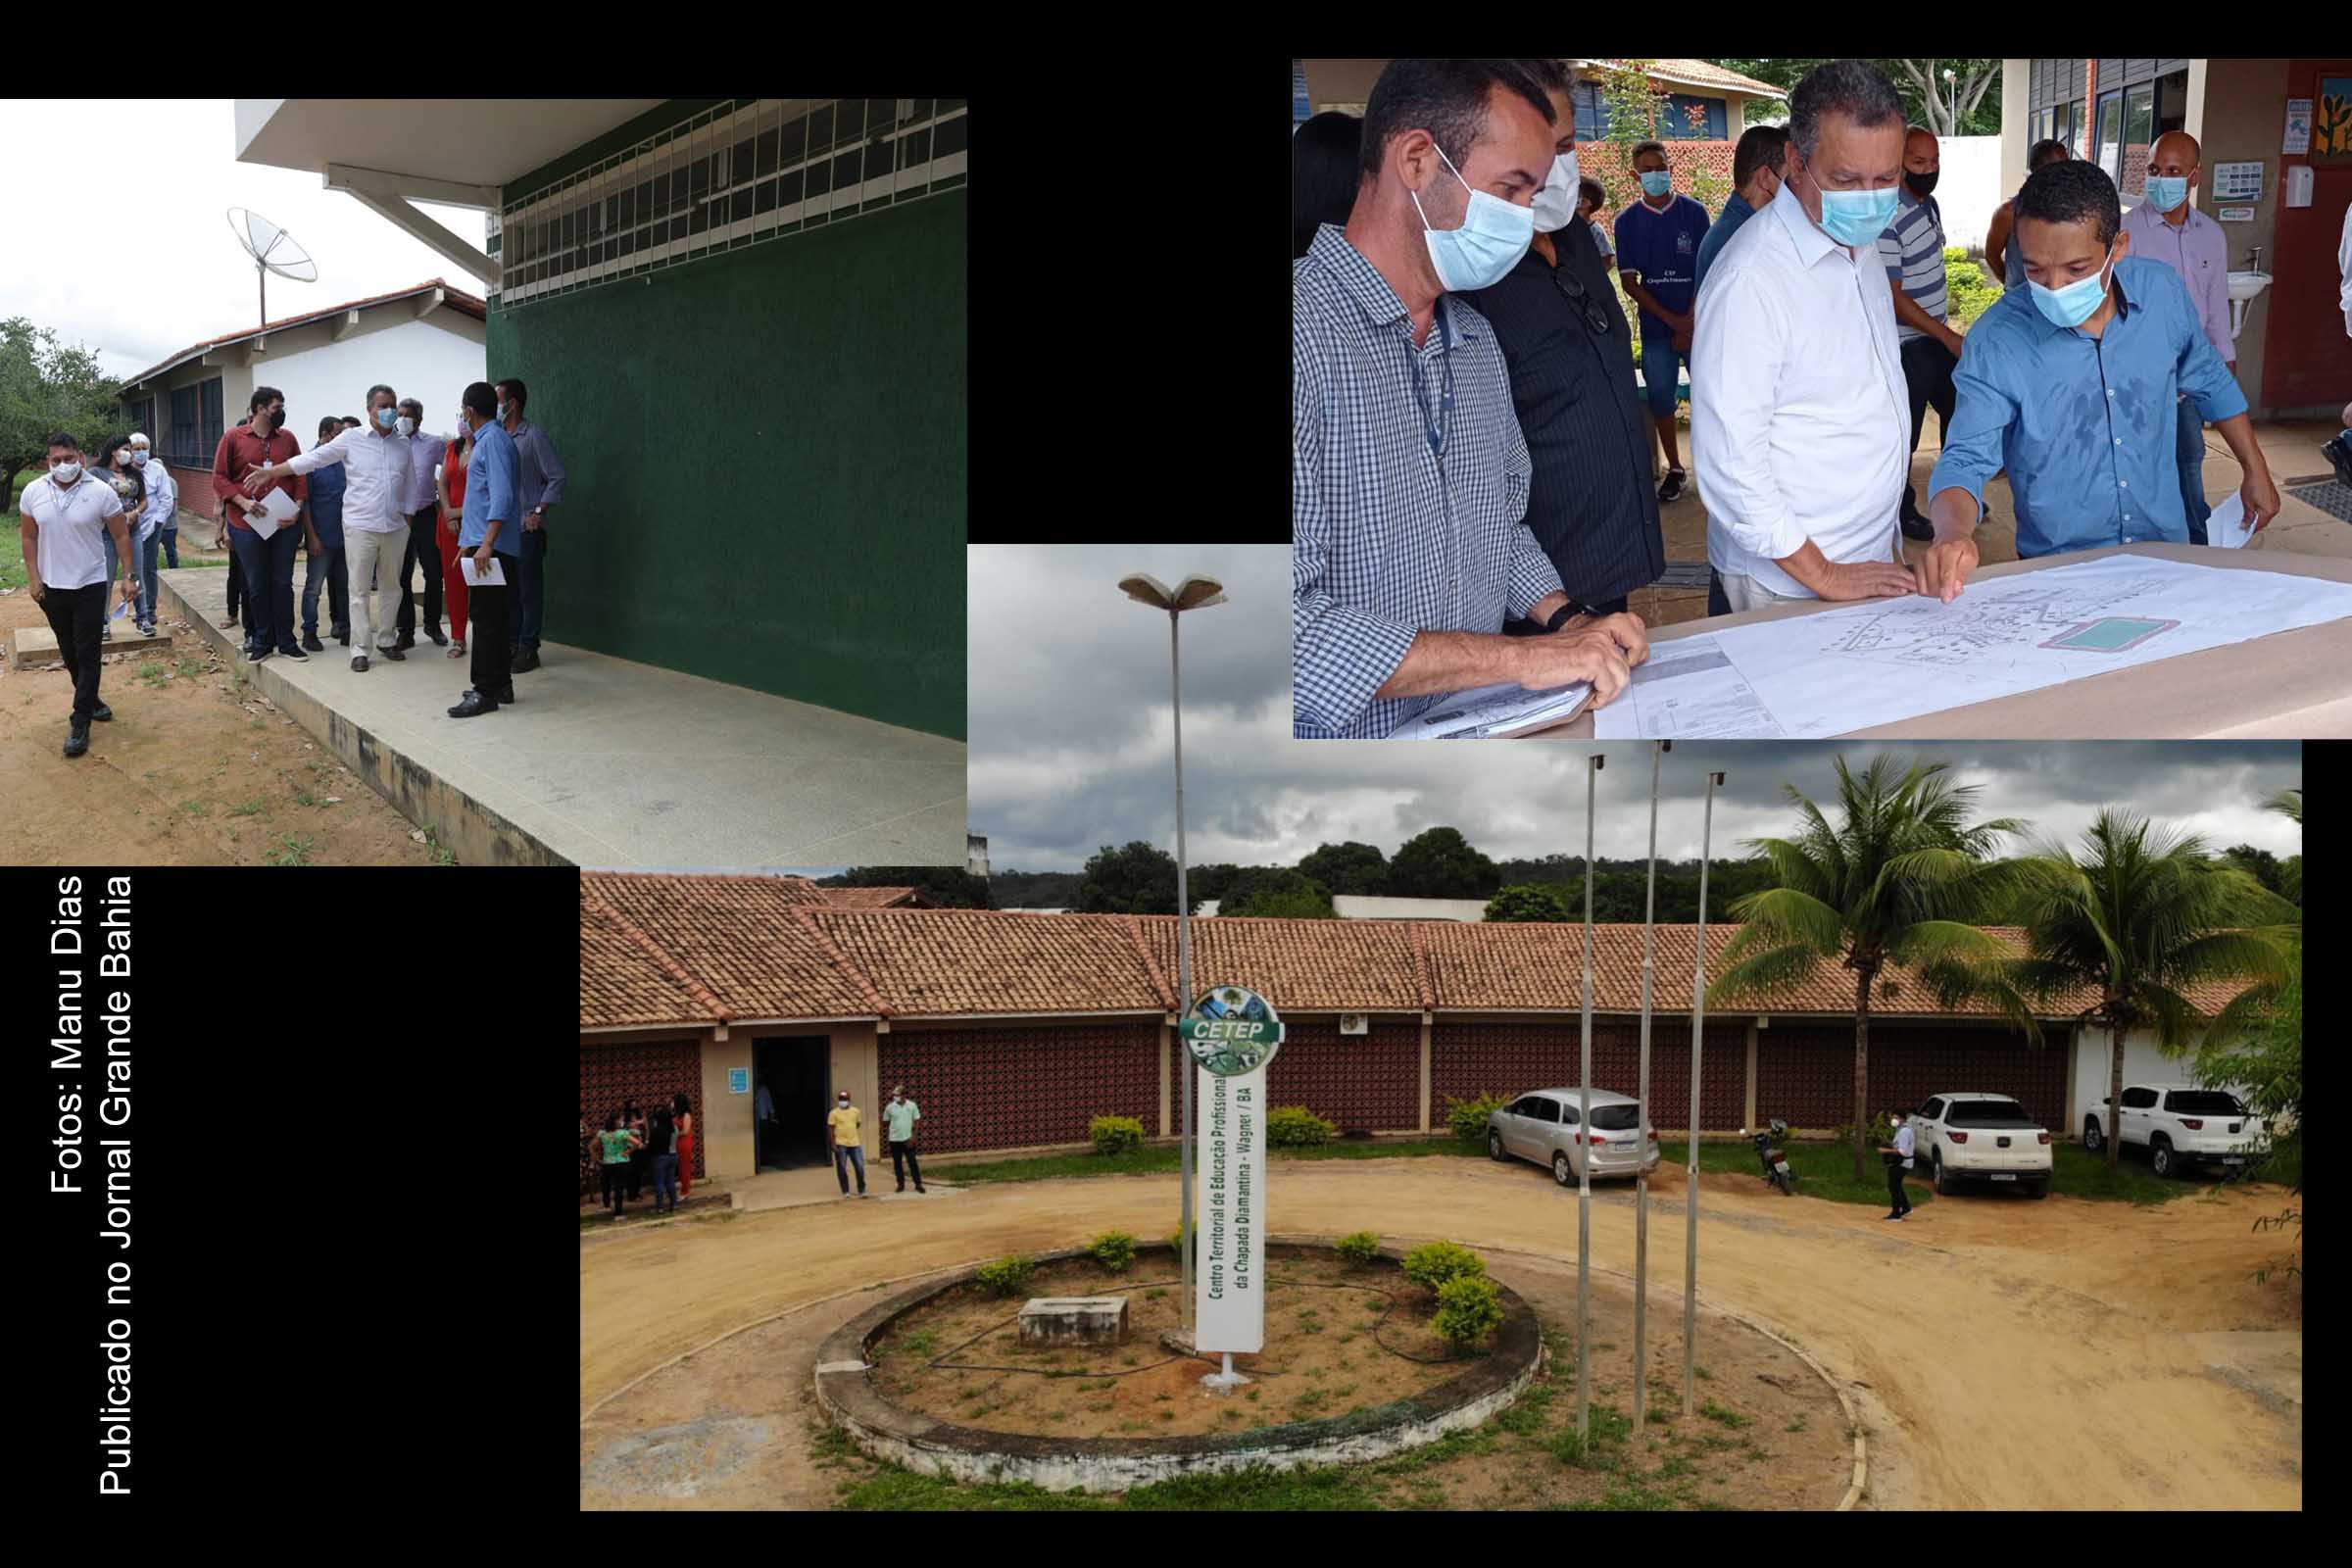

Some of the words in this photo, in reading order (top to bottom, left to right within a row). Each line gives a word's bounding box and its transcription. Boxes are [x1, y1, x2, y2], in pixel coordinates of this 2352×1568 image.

[1194, 1021, 1264, 1039] CETEP
[1236, 1088, 1251, 1102] BA
[1236, 1114, 1253, 1152] Wagner
[1209, 1140, 1228, 1190] Educação
[1209, 1193, 1225, 1205] de
[1235, 1164, 1250, 1224] Diamantina
[1208, 1208, 1225, 1261] Territorial
[1234, 1227, 1250, 1272] Chapada
[1208, 1265, 1224, 1299] Centro
[1234, 1276, 1249, 1289] da
